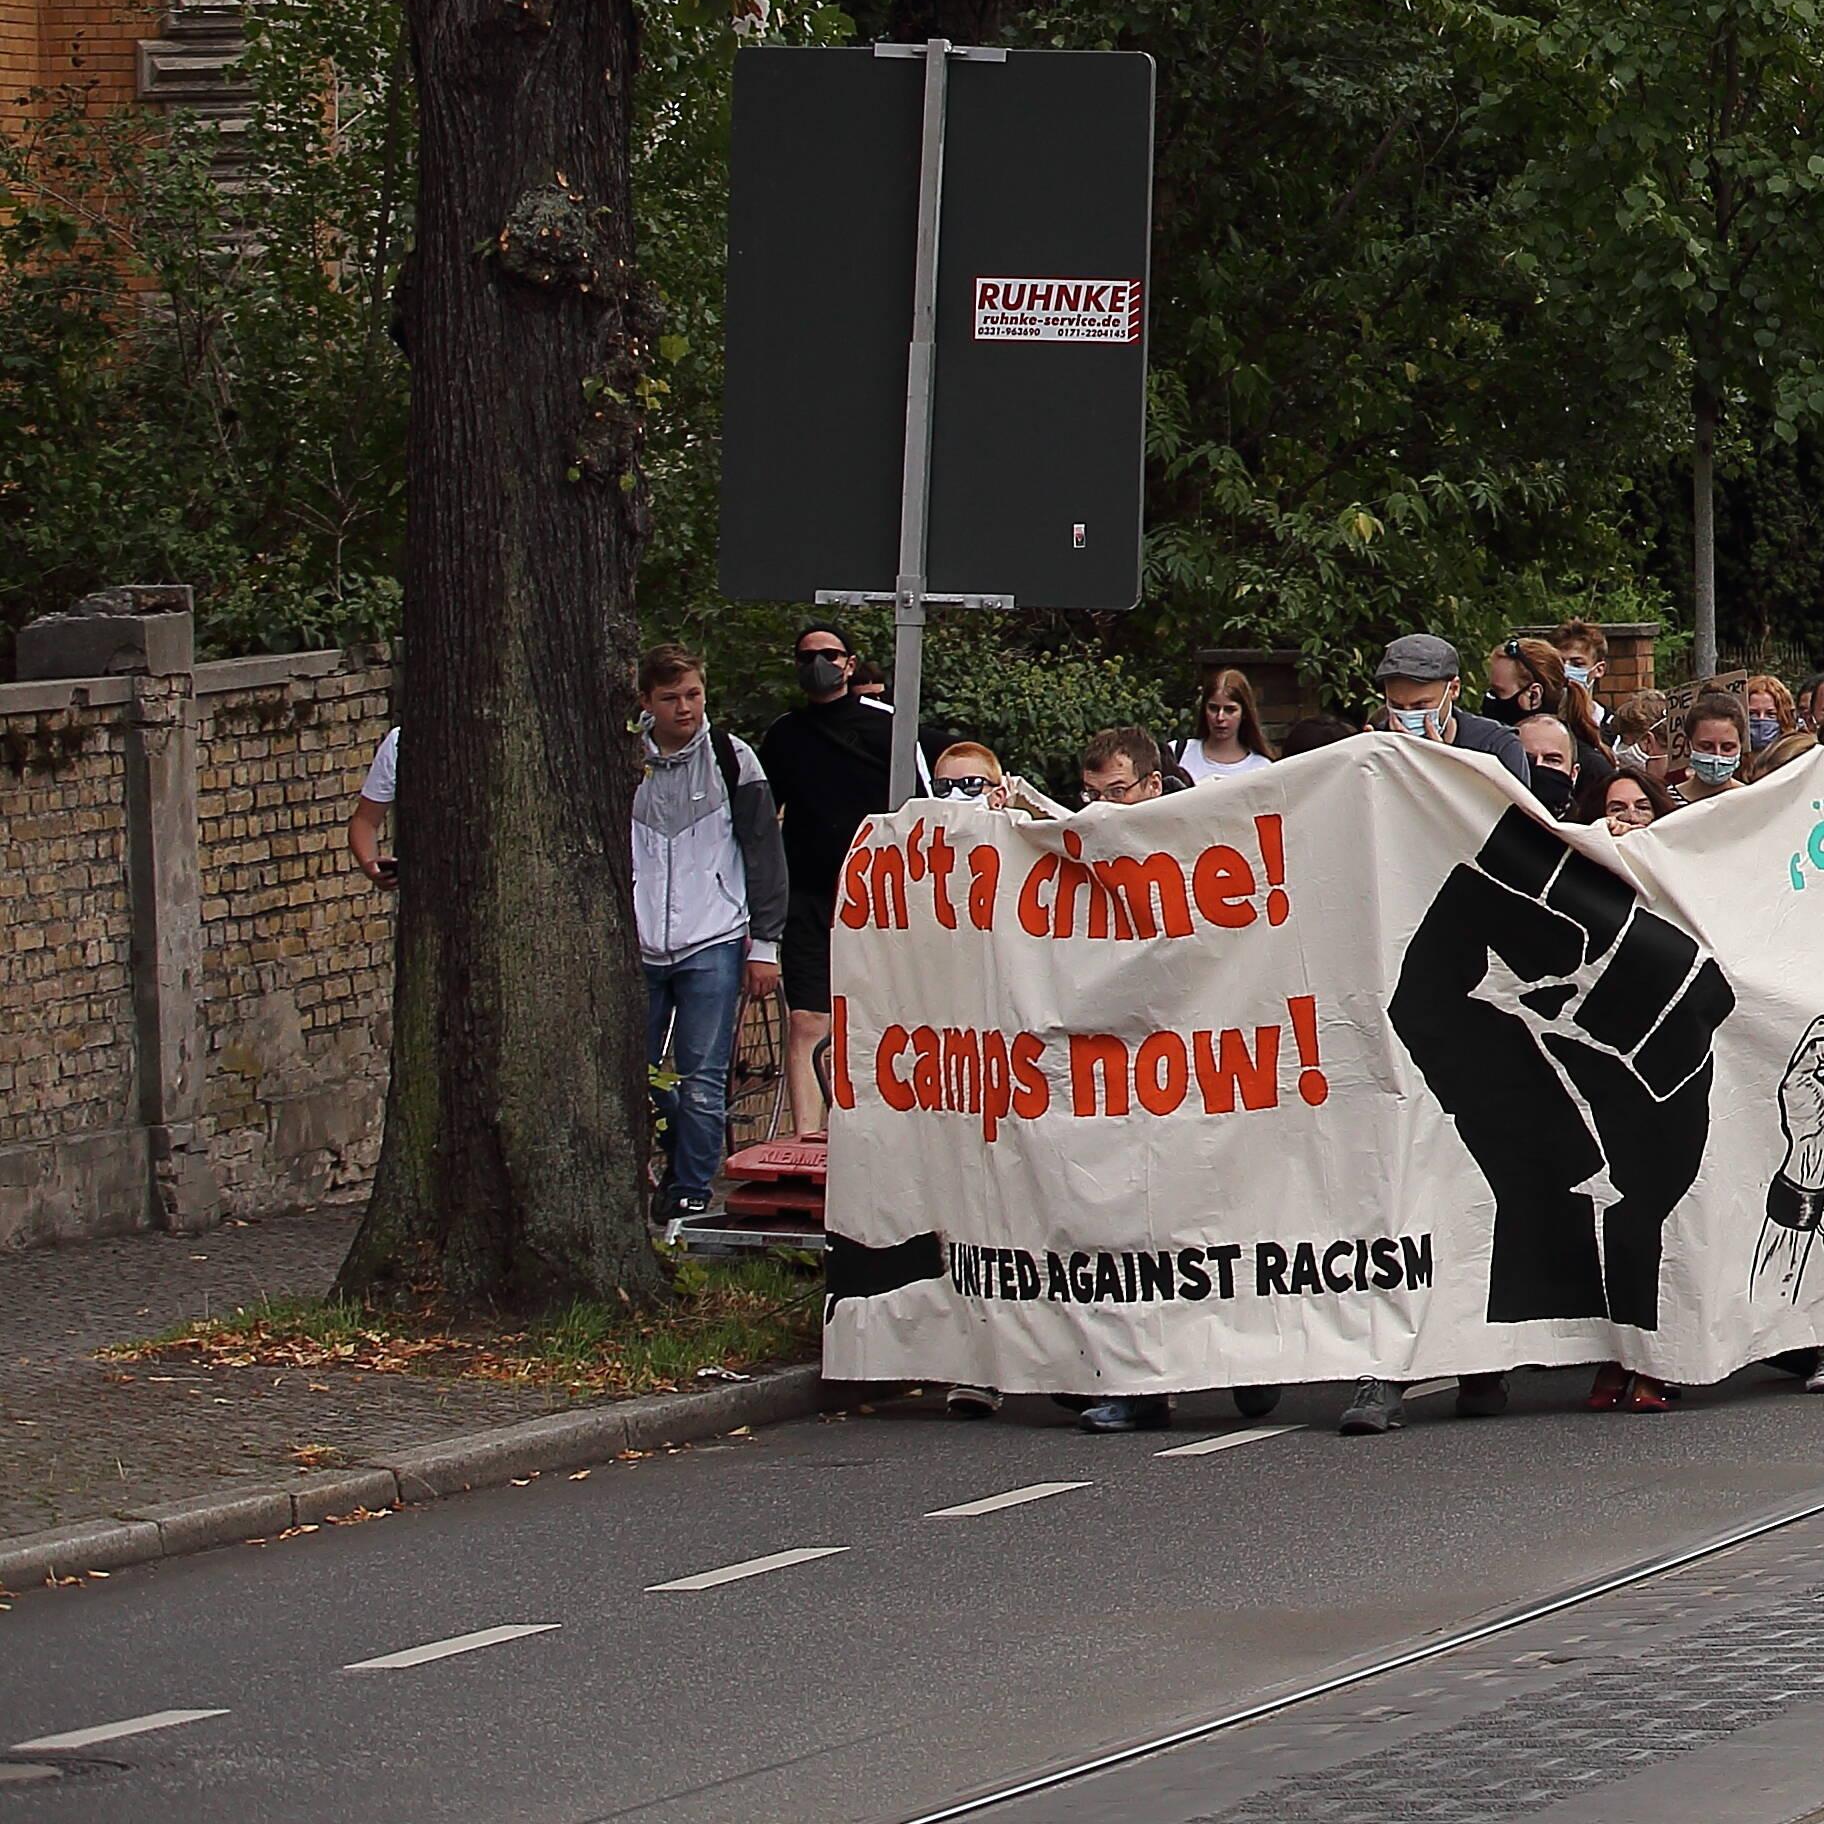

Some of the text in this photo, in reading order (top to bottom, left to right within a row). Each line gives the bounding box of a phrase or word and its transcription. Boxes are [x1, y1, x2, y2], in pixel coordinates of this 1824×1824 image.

[977, 283, 1128, 313] RUHNKE
[982, 312, 1121, 328] ruhnke-service.de
[977, 327, 1041, 337] 0331-963690
[967, 845, 1000, 932] a
[1017, 813, 1290, 941] crime!
[876, 1024, 1050, 1143] camps
[1068, 994, 1329, 1116] now!
[948, 1233, 1435, 1304] UNITED AGAINST RACISM
